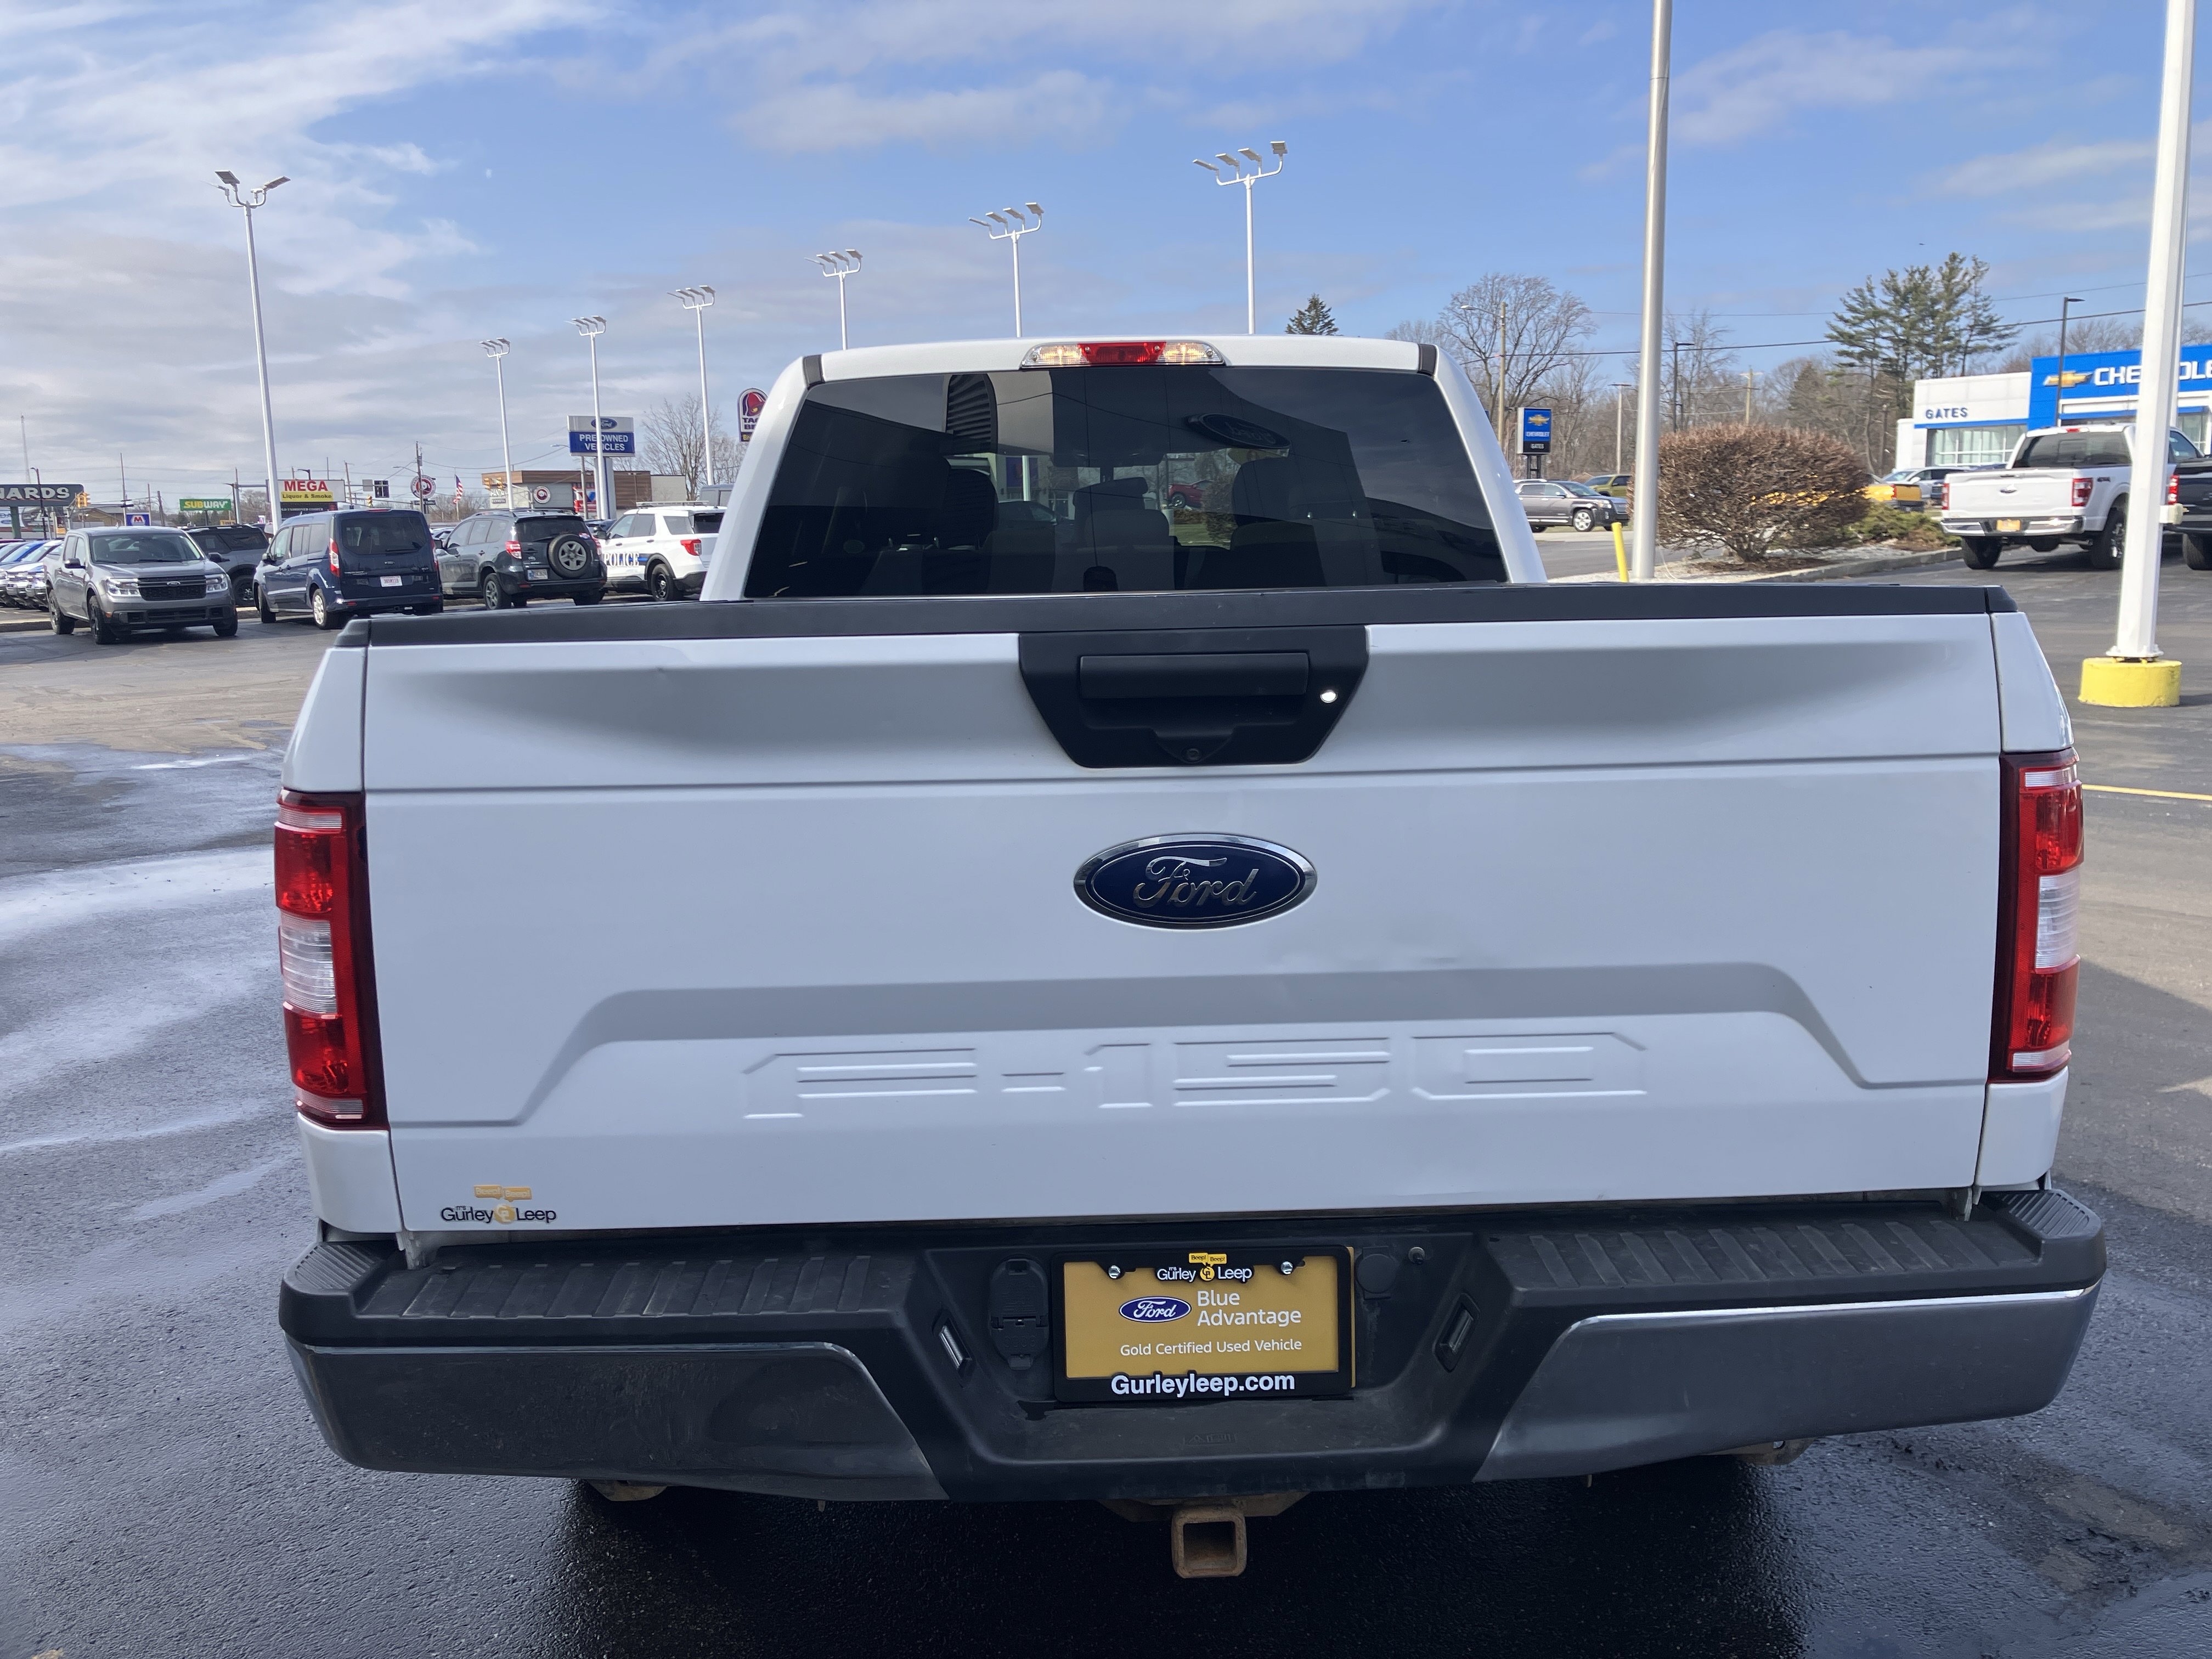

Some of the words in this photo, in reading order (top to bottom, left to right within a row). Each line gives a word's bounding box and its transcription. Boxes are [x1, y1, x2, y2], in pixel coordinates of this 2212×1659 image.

[2095, 360, 2212, 386] CHEOL
[1926, 407, 1968, 419] GATES
[579, 434, 629, 442] PREOWNED
[584, 443, 625, 451] VEICLES
[284, 481, 328, 492] MEGA
[183, 500, 228, 509] SUBWAY
[604, 551, 640, 567] POLICE
[1133, 855, 1259, 909] Ford
[743, 1031, 1646, 1119] F-150
[441, 1206, 494, 1223] Gurley
[516, 1207, 557, 1223] Leep
[1156, 1267, 1197, 1283] Gurley
[1217, 1266, 1252, 1282] Leep
[1197, 1289, 1240, 1307] Blue
[1132, 1300, 1176, 1318] Ford
[1197, 1308, 1302, 1328] Advantage
[1120, 1344, 1152, 1356] Gold
[1155, 1341, 1212, 1355] Certified
[1216, 1340, 1250, 1353] Used
[1254, 1338, 1302, 1352] Vehicle
[1111, 1374, 1296, 1398] Gurleyleep.com
